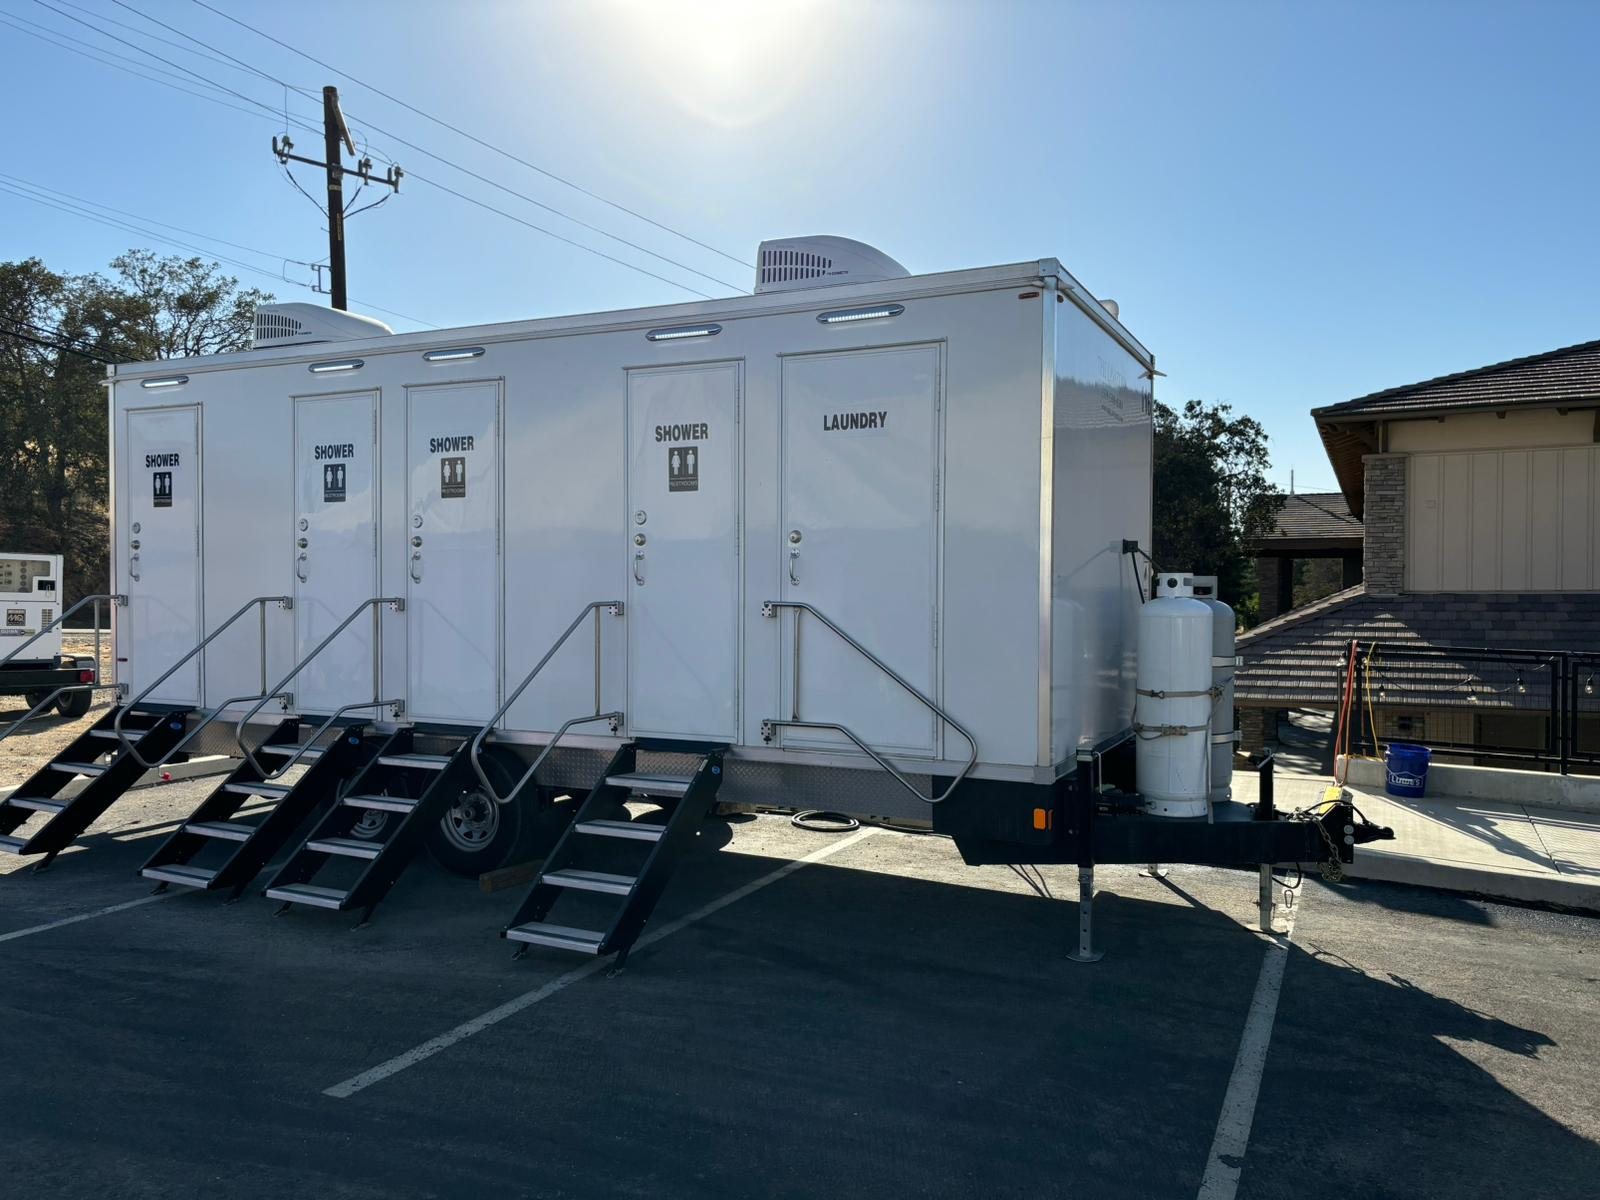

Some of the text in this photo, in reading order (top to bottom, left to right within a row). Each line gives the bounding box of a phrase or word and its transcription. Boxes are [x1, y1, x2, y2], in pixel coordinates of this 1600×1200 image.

[823, 411, 887, 431] LAUNDRY
[655, 422, 708, 442] SHOWER
[314, 443, 354, 460] SHOWER
[430, 435, 474, 453] SHOWER
[145, 453, 180, 468] SHOWER
